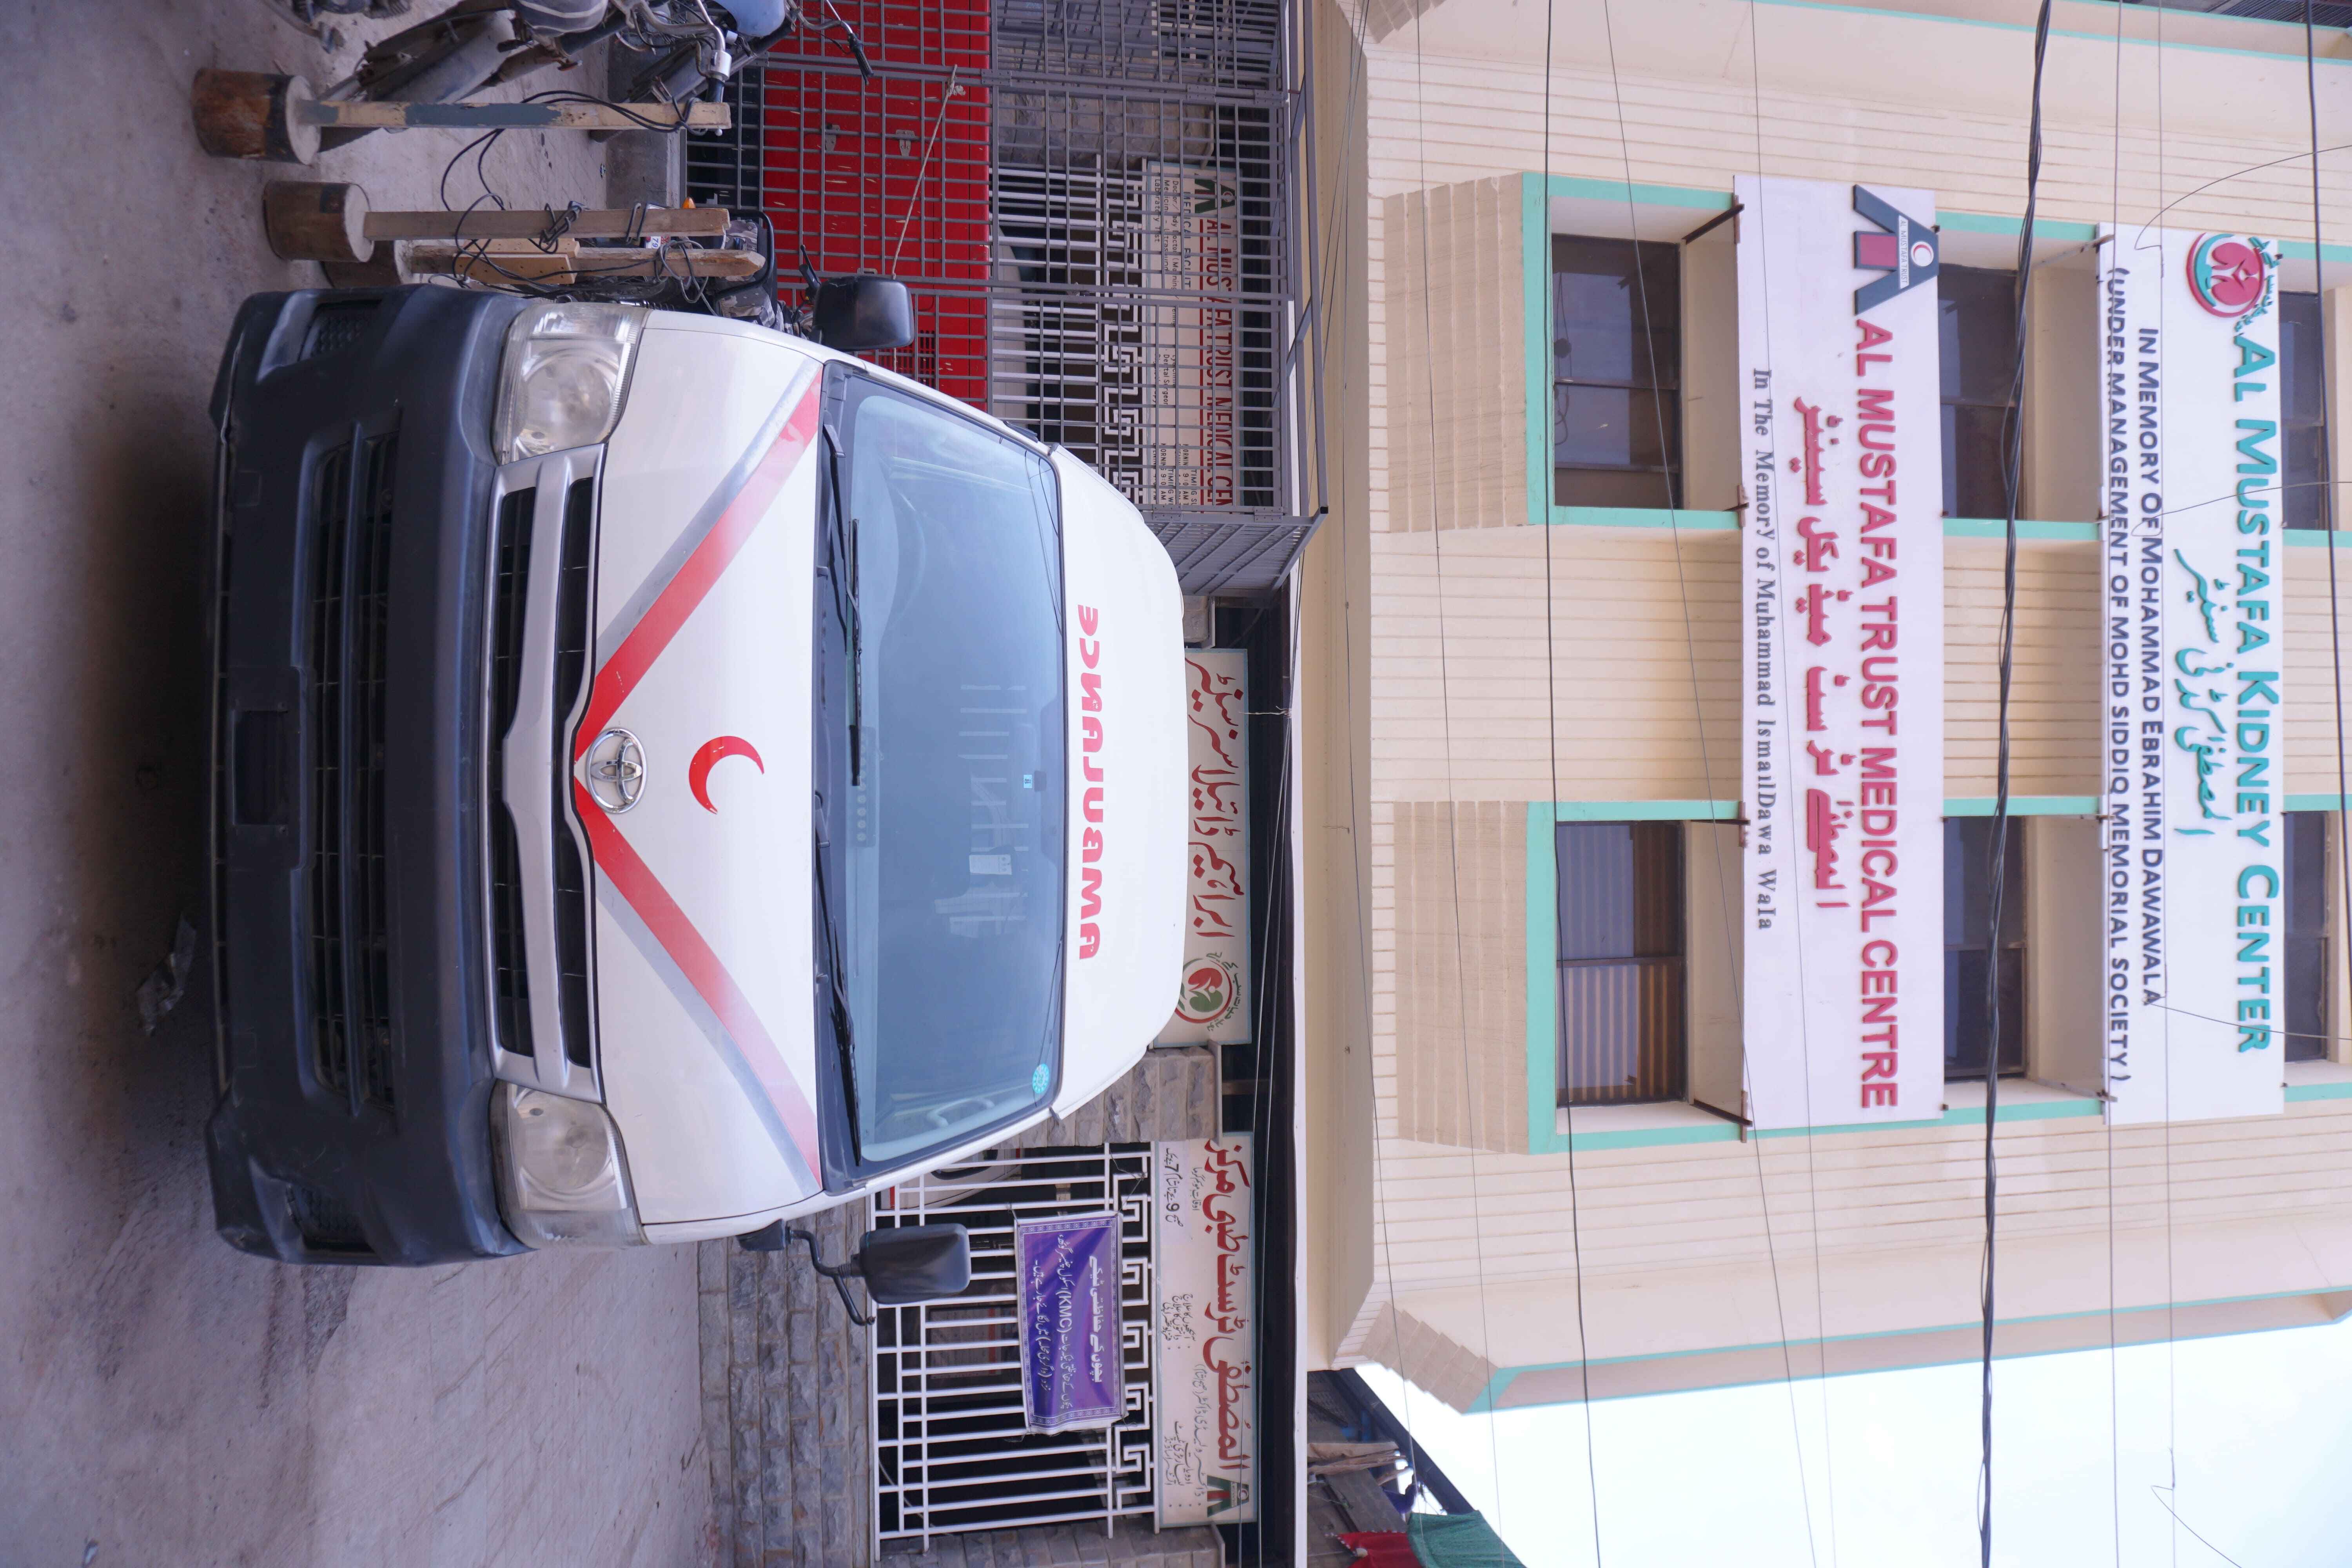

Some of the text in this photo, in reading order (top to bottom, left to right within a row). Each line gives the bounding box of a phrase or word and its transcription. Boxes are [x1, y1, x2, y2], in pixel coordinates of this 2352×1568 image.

[1206, 247, 1232, 327] MUSAFA
[1753, 368, 1772, 389] In
[1754, 399, 1773, 436] The
[1755, 448, 1775, 540] Memory
[2109, 373, 2128, 567] MANAGEMENT
[1756, 547, 1775, 571] of
[2111, 575, 2129, 608] OF
[1756, 578, 1776, 706] Muhammad
[2111, 616, 2129, 698] MOHD
[2138, 328, 2163, 1006] IN MEMORY OF MOHAMMAD EBRAHIM DAWAWALA
[1857, 319, 1898, 1108] AL MUSTAFA TRUST MEDICAL CENTRE
[2235, 336, 2279, 1053] AL MUSTAFA KIDNEY CENTER
[2110, 706, 2129, 795] SIDDIQ
[1188, 842, 1245, 938] ابراہیم
[2111, 804, 2130, 948] MEMORIAL
[1164, 1163, 1180, 1172] 7
[1204, 1139, 1250, 1194] مرکز
[1166, 1203, 1180, 1212] 9
[1203, 1194, 1249, 1252] طبی
[1055, 1290, 1073, 1333] (KMC)
[1056, 1269, 1076, 1290] اسکول
[1204, 1254, 1249, 1333] ٹرسٹ
[1089, 1256, 1105, 1383] بچوں کے حفاظتی ٹیکے
[1060, 1394, 1073, 1409] بچوں
[1062, 1381, 1074, 1392] کے
